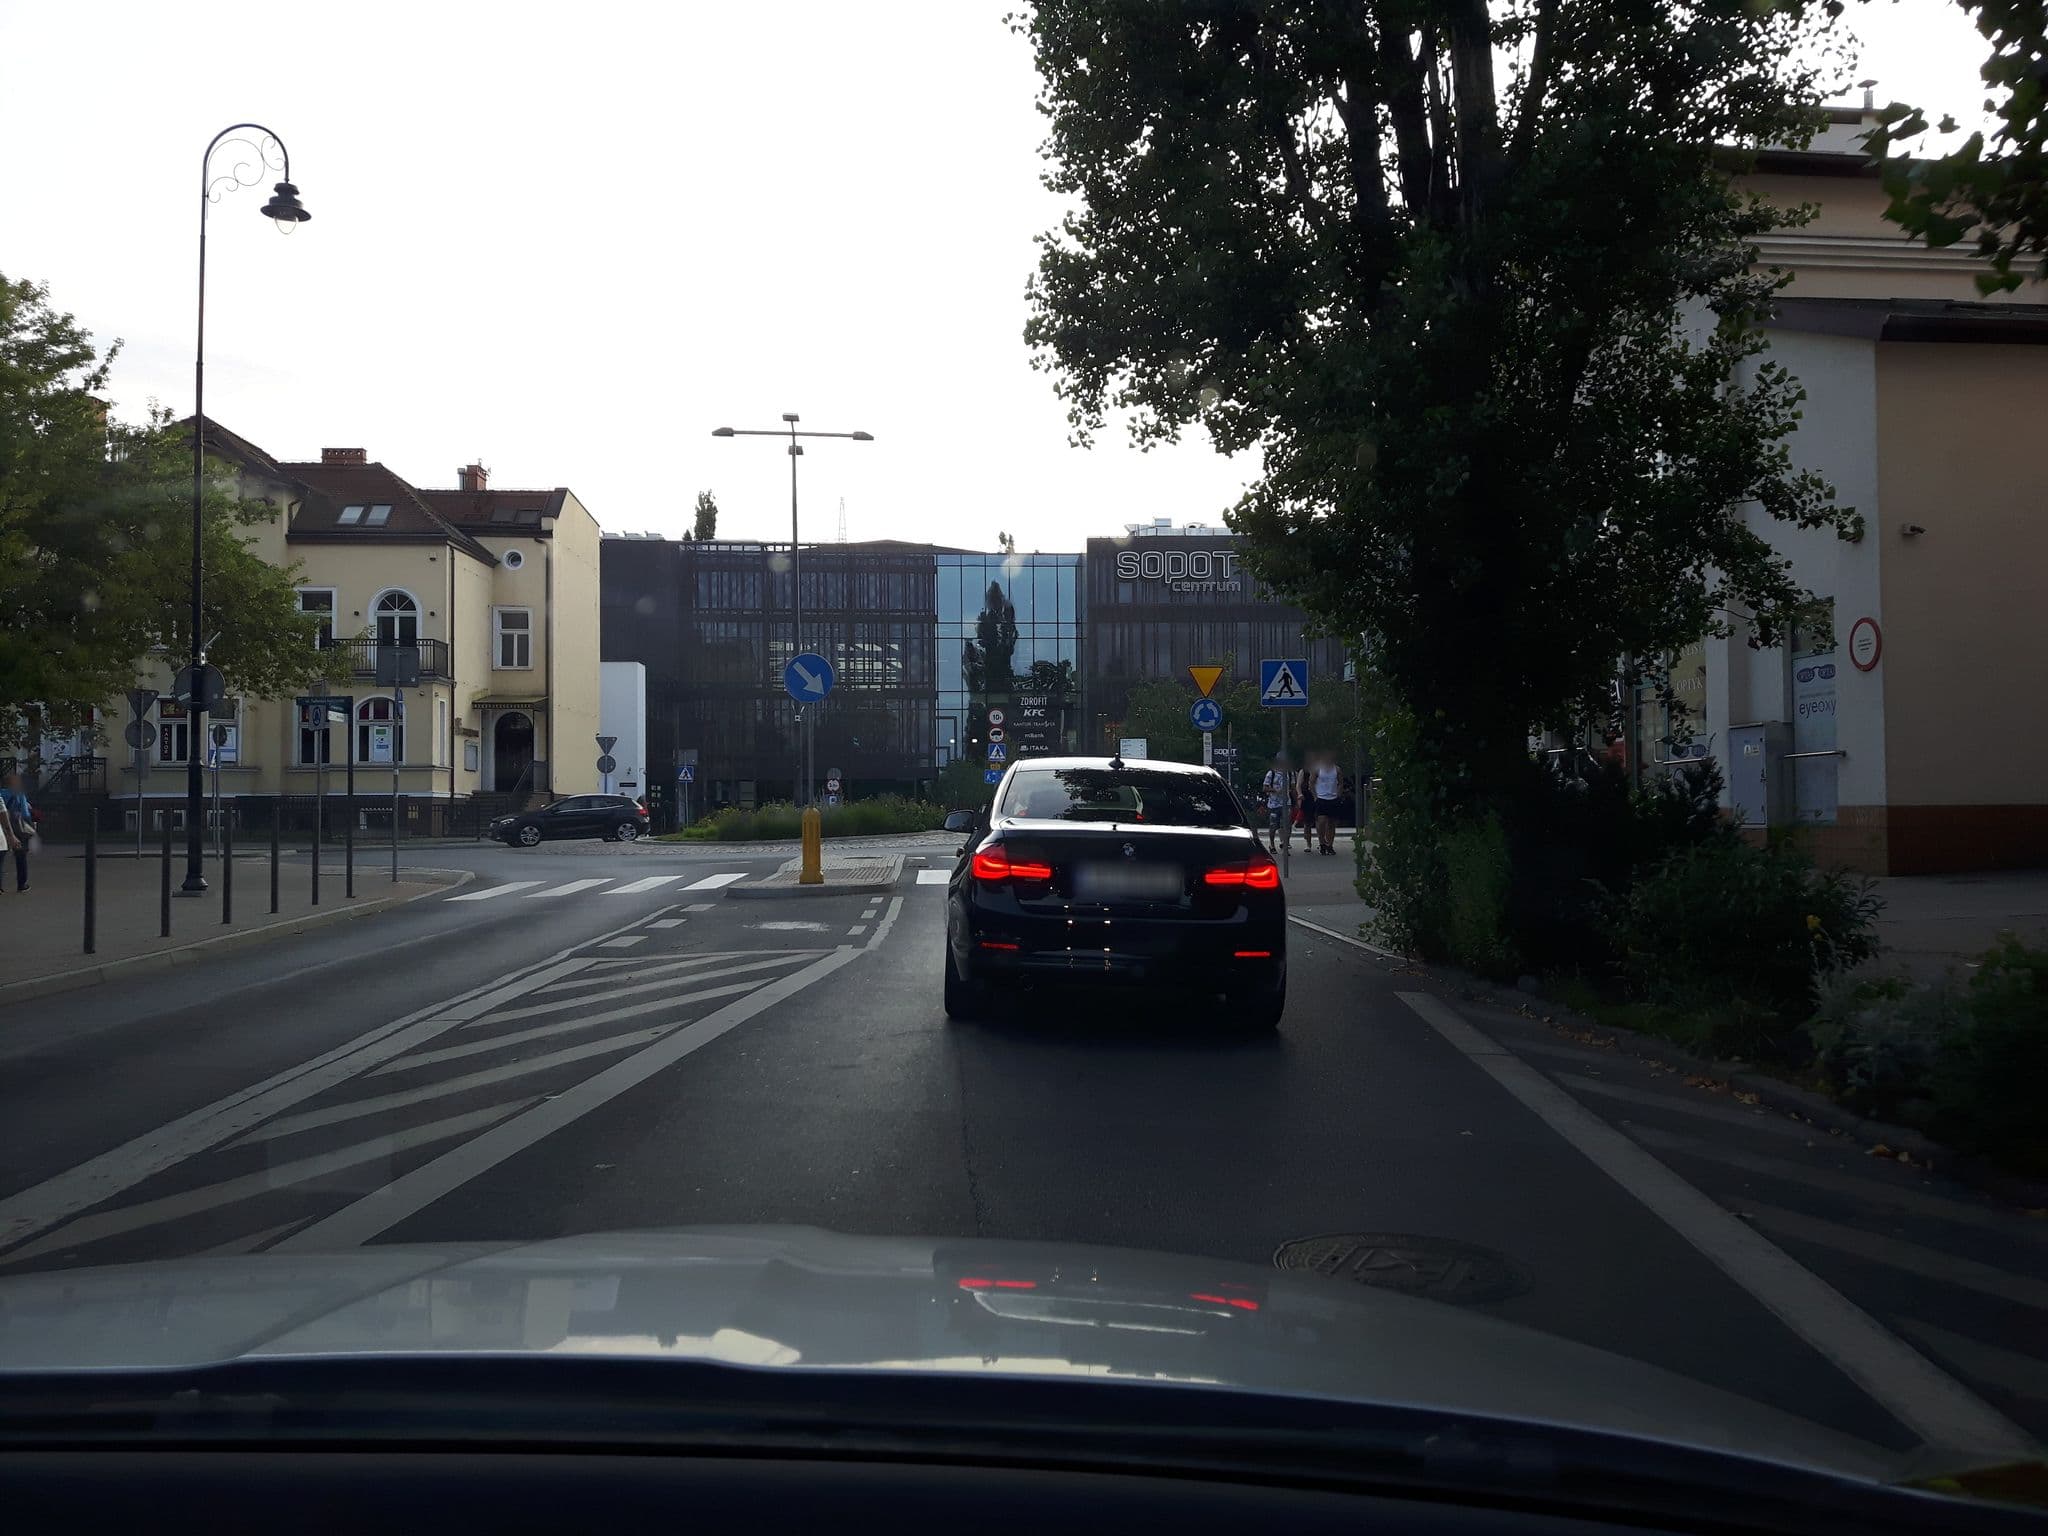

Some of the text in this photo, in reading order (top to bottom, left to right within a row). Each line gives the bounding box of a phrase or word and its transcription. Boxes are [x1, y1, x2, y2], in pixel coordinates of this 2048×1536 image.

[1020, 697, 1047, 706] ZDROFIT
[1023, 709, 1045, 717] KFC
[1800, 700, 1836, 718] eyeoxy
